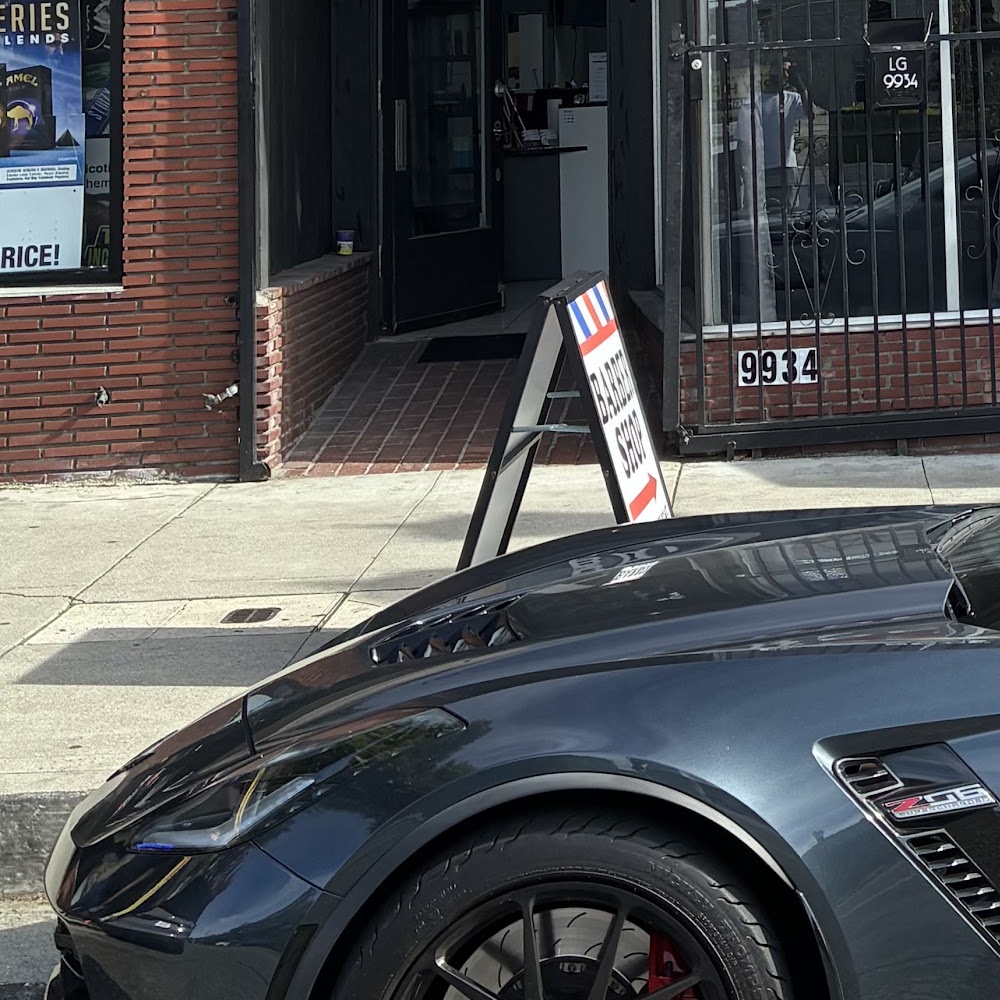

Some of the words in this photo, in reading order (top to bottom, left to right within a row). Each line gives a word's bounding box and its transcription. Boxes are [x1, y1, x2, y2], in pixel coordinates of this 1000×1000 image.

[4, 33, 70, 45] LENDS
[889, 56, 907, 71] LG
[883, 73, 918, 89] 9934
[1, 244, 60, 269] RICE!
[741, 350, 818, 385] 9934
[615, 409, 647, 479] SHOP
